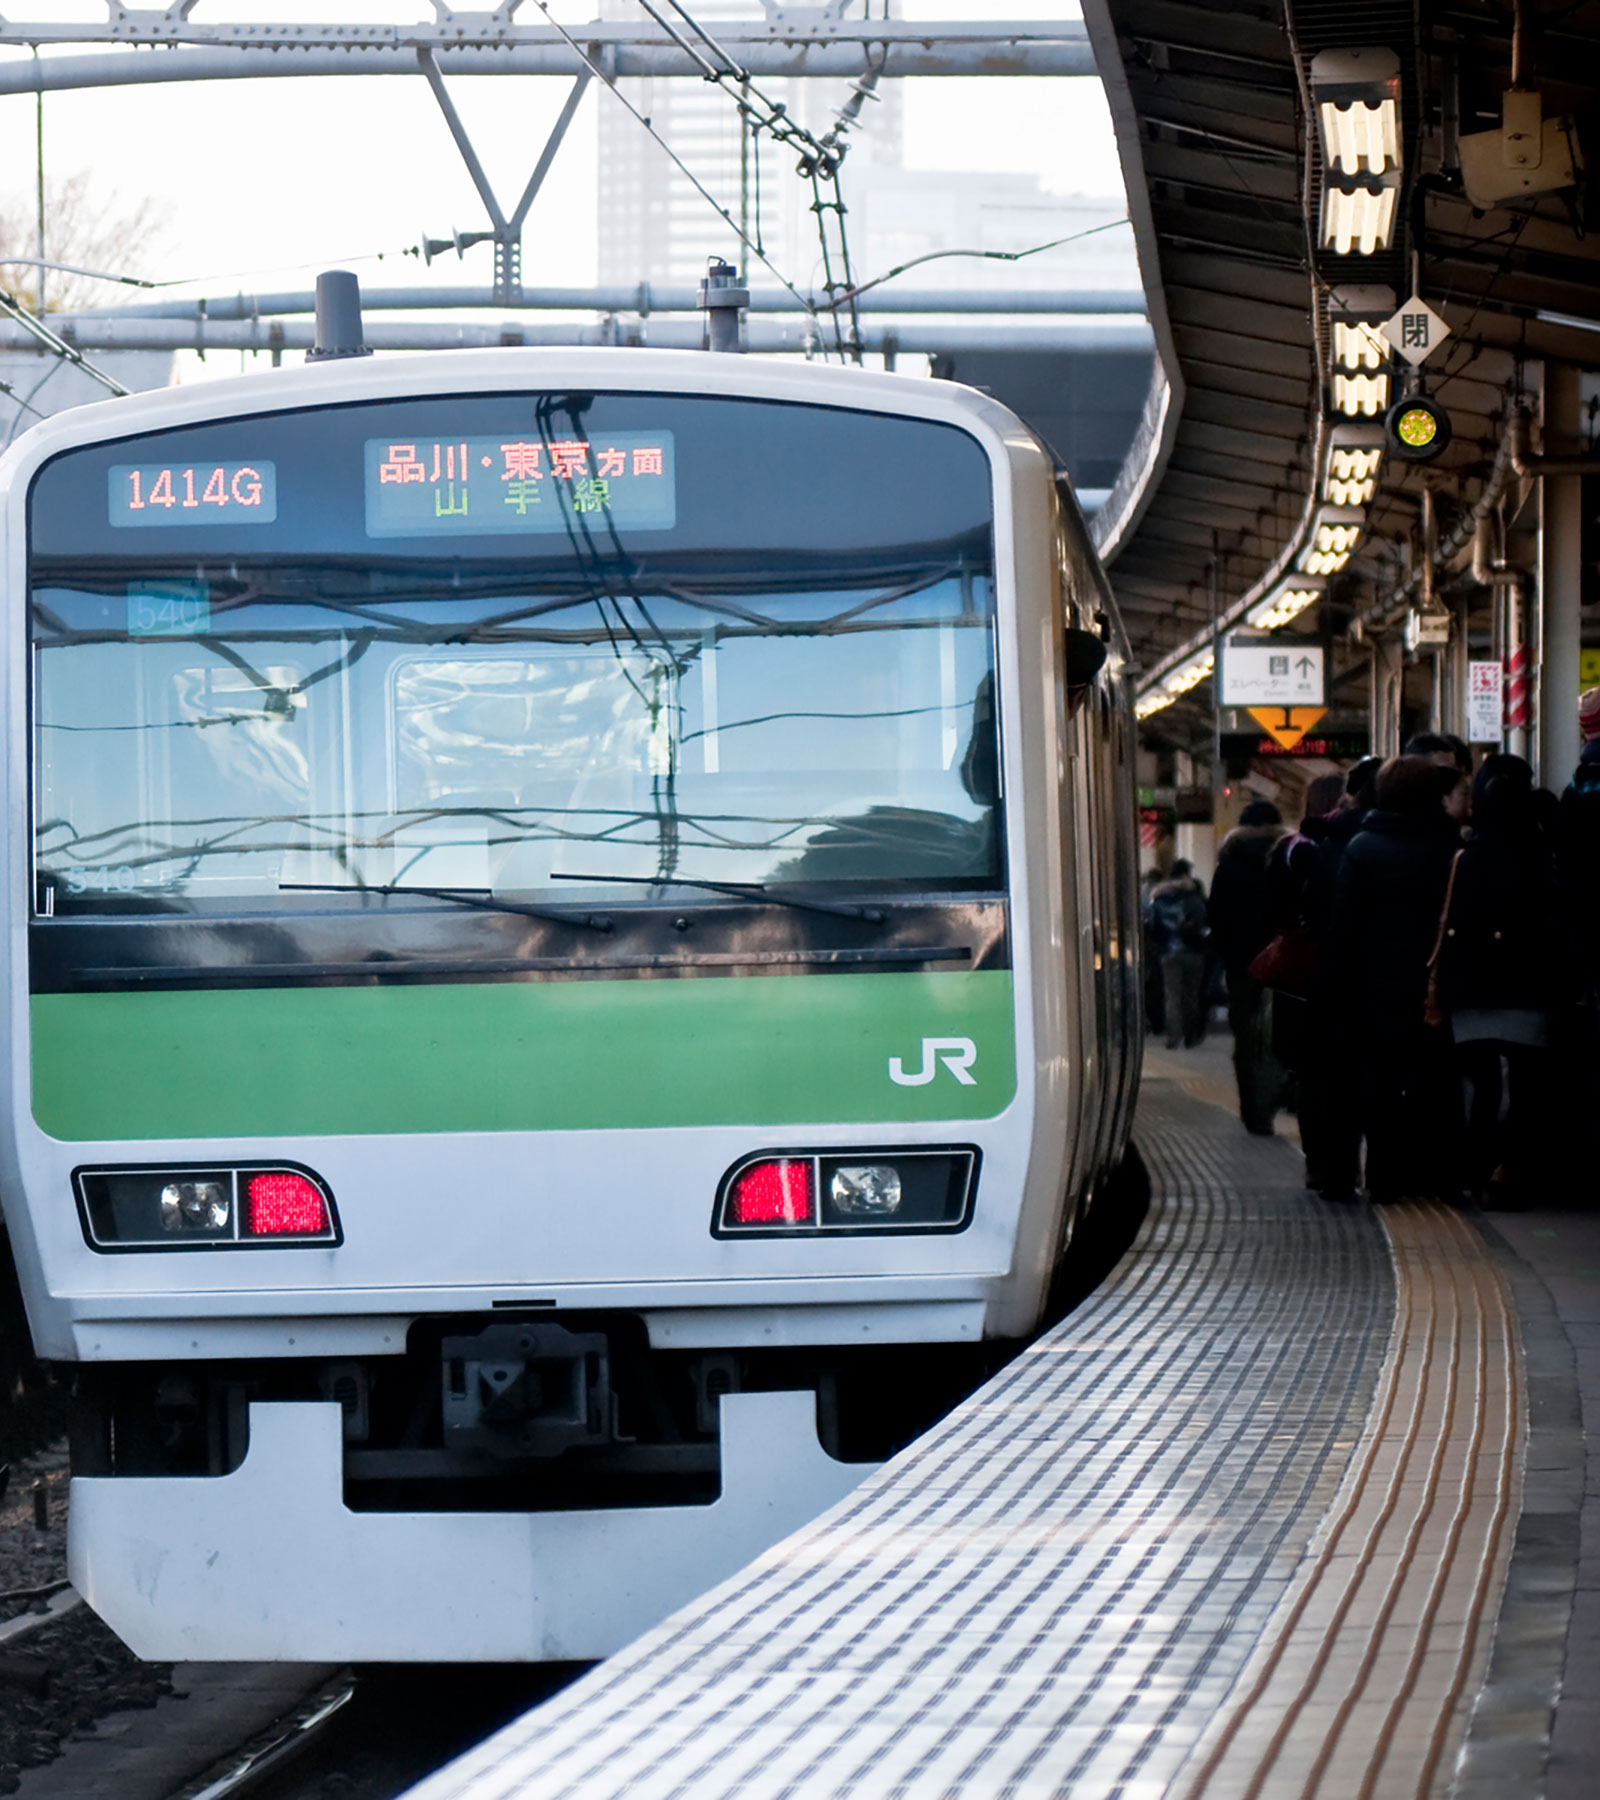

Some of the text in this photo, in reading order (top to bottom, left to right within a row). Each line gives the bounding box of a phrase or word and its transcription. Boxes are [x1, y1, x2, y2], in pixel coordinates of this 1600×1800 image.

[1402, 313, 1429, 348] 閉
[129, 466, 262, 509] 1414G
[137, 594, 199, 630] 540
[66, 865, 136, 893] 540
[888, 1037, 978, 1086] JR
